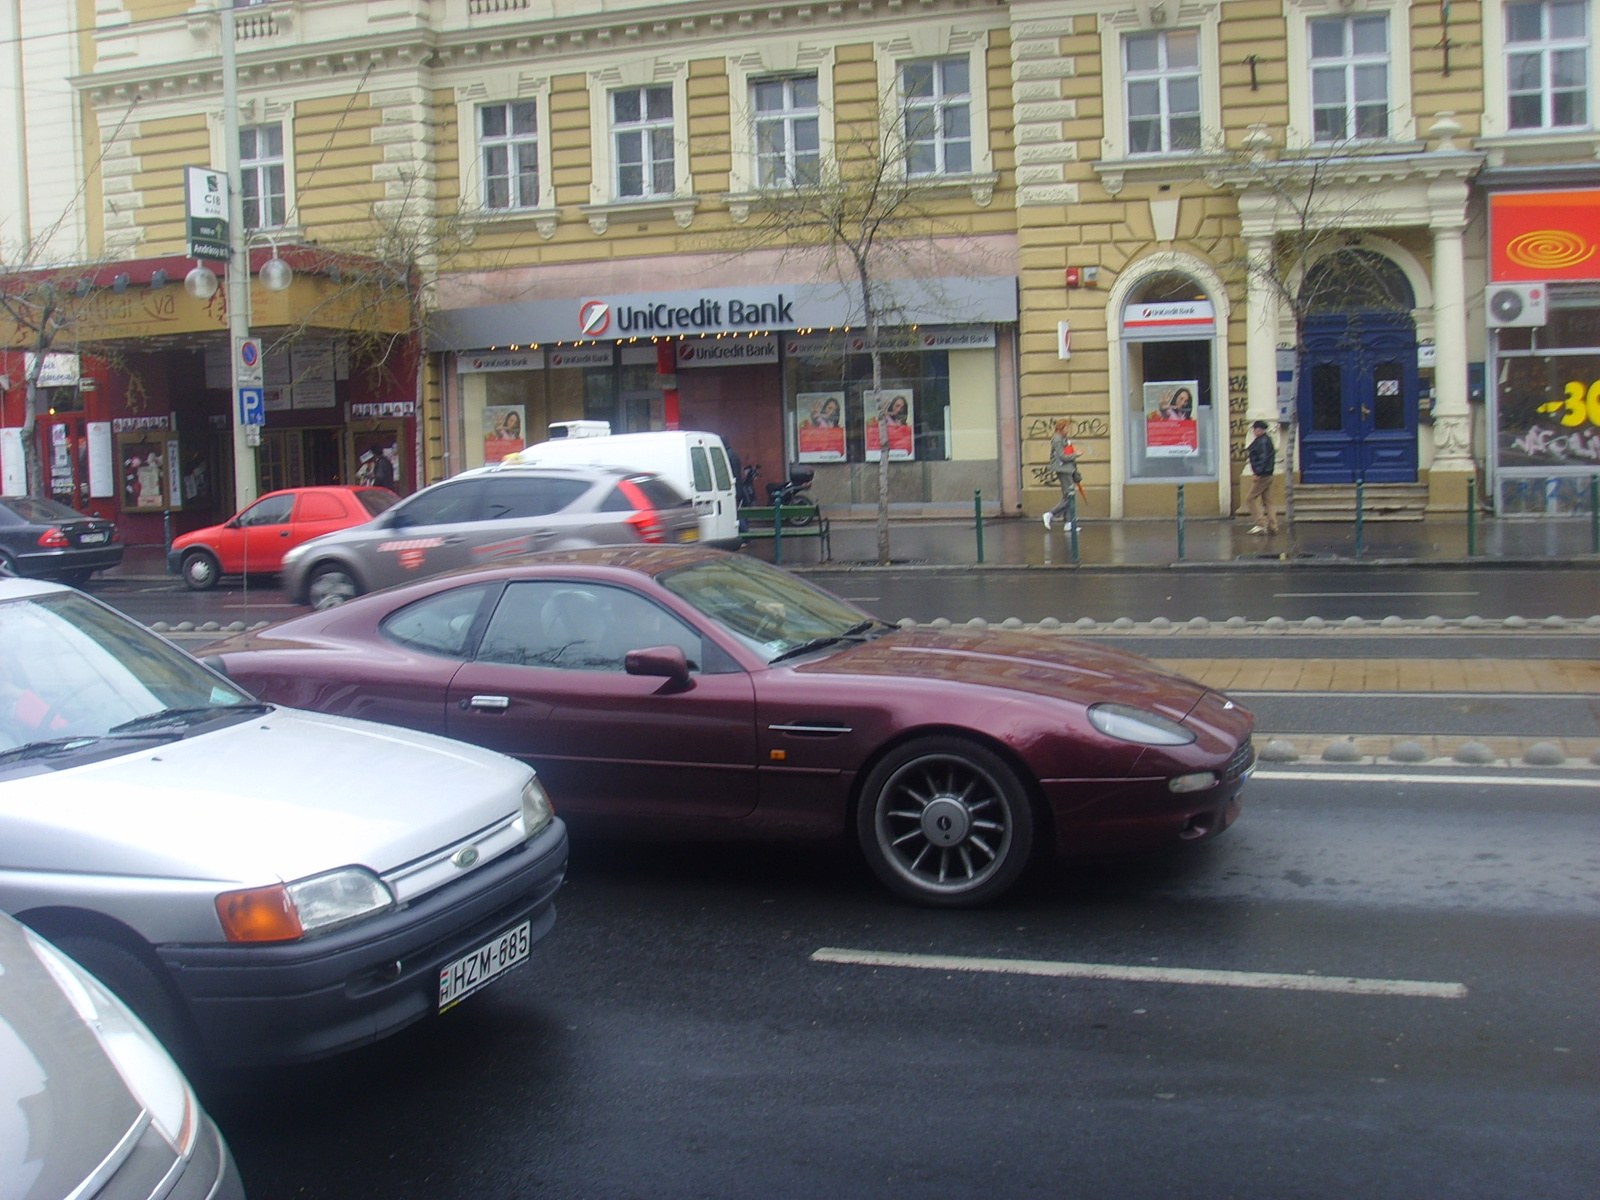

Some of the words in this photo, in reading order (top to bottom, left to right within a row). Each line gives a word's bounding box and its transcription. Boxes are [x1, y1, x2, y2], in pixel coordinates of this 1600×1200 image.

[204, 194, 221, 206] CIB
[616, 299, 722, 332] UniCredit
[728, 293, 794, 325] Bank
[1179, 305, 1195, 315] Bank
[936, 335, 968, 345] UniCredit
[969, 333, 990, 344] Bank
[592, 352, 610, 362] Bank
[696, 342, 745, 361] UniCredit
[746, 340, 775, 357] Bank
[511, 356, 528, 367] Bank
[242, 390, 259, 424] P
[454, 925, 528, 995] HZM-685
[440, 985, 449, 1003] H
